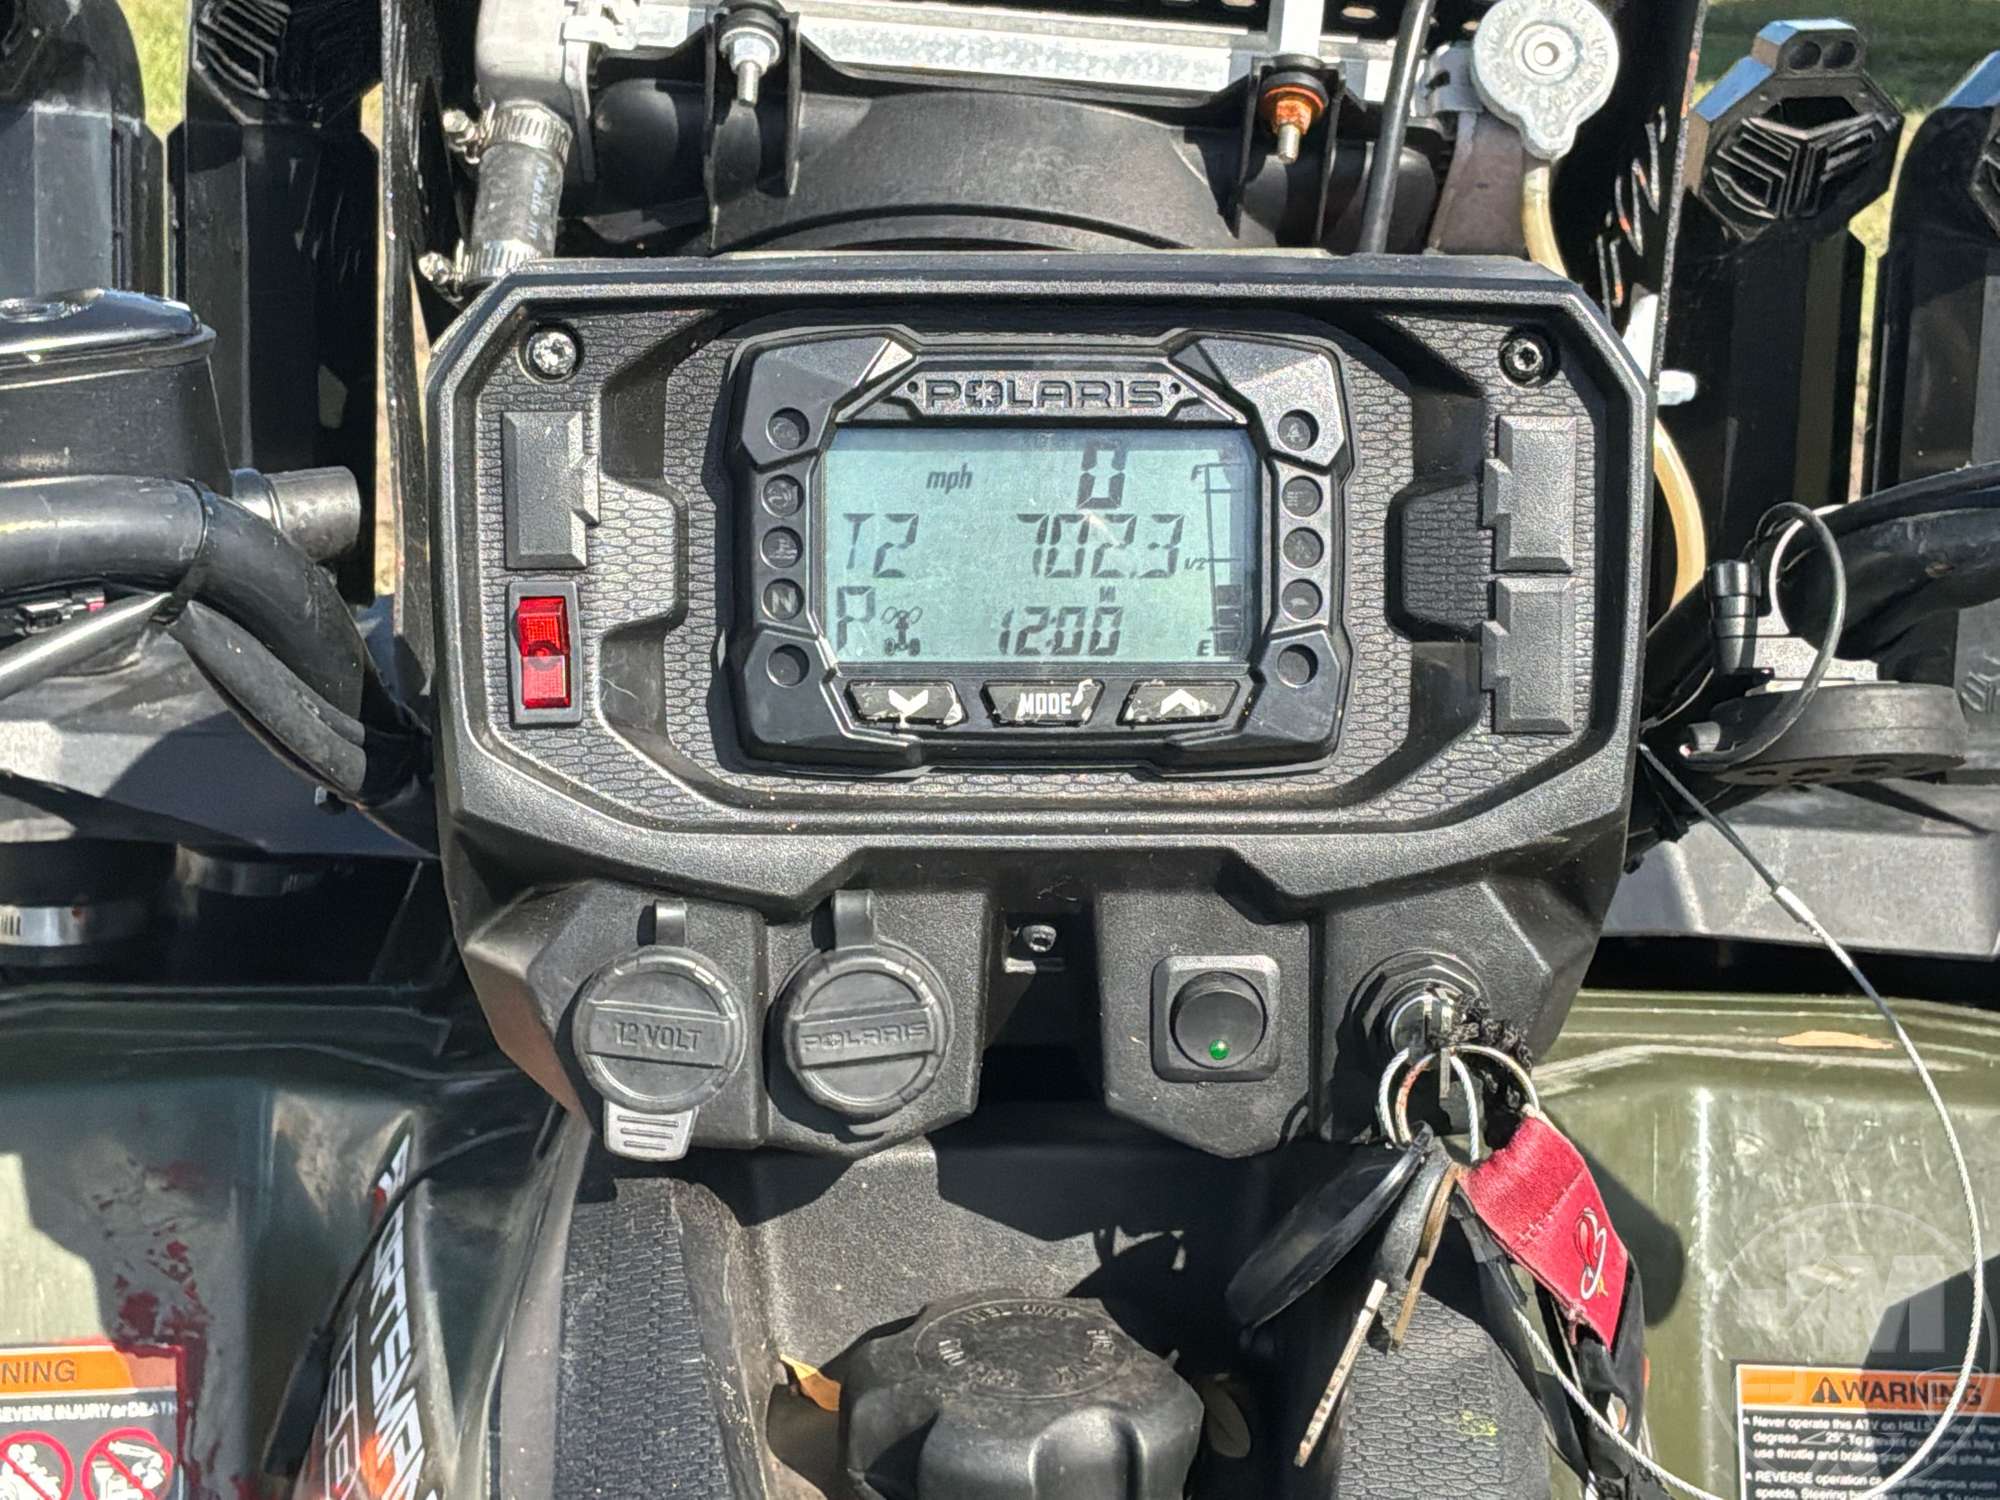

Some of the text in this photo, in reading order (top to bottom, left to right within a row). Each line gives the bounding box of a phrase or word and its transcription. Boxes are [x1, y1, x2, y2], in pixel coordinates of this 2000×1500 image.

[925, 379, 1164, 408] POLARIS
[926, 463, 973, 495] mph
[1076, 437, 1128, 509] 0
[843, 513, 919, 578] T2
[1016, 513, 1185, 578] 702.3
[836, 585, 876, 651] P
[998, 606, 1123, 656] 12:00
[1197, 640, 1212, 656] E
[1016, 693, 1073, 717] MODE
[614, 1022, 703, 1053] 12 VOLT
[800, 1021, 930, 1052] POLARIS
[1842, 1379, 1982, 1408] WARNING
[1752, 1415, 1786, 1428] Never
[1788, 1418, 1831, 1431] operate
[1832, 1418, 1853, 1431] this
[1753, 1431, 1799, 1446] degrees
[1754, 1449, 1775, 1460] use
[1776, 1447, 1815, 1461] throttle
[1816, 1450, 1839, 1462] and
[1840, 1450, 1878, 1464] brakes
[1755, 1470, 1814, 1484] REVERSE
[1815, 1474, 1868, 1488] operation
